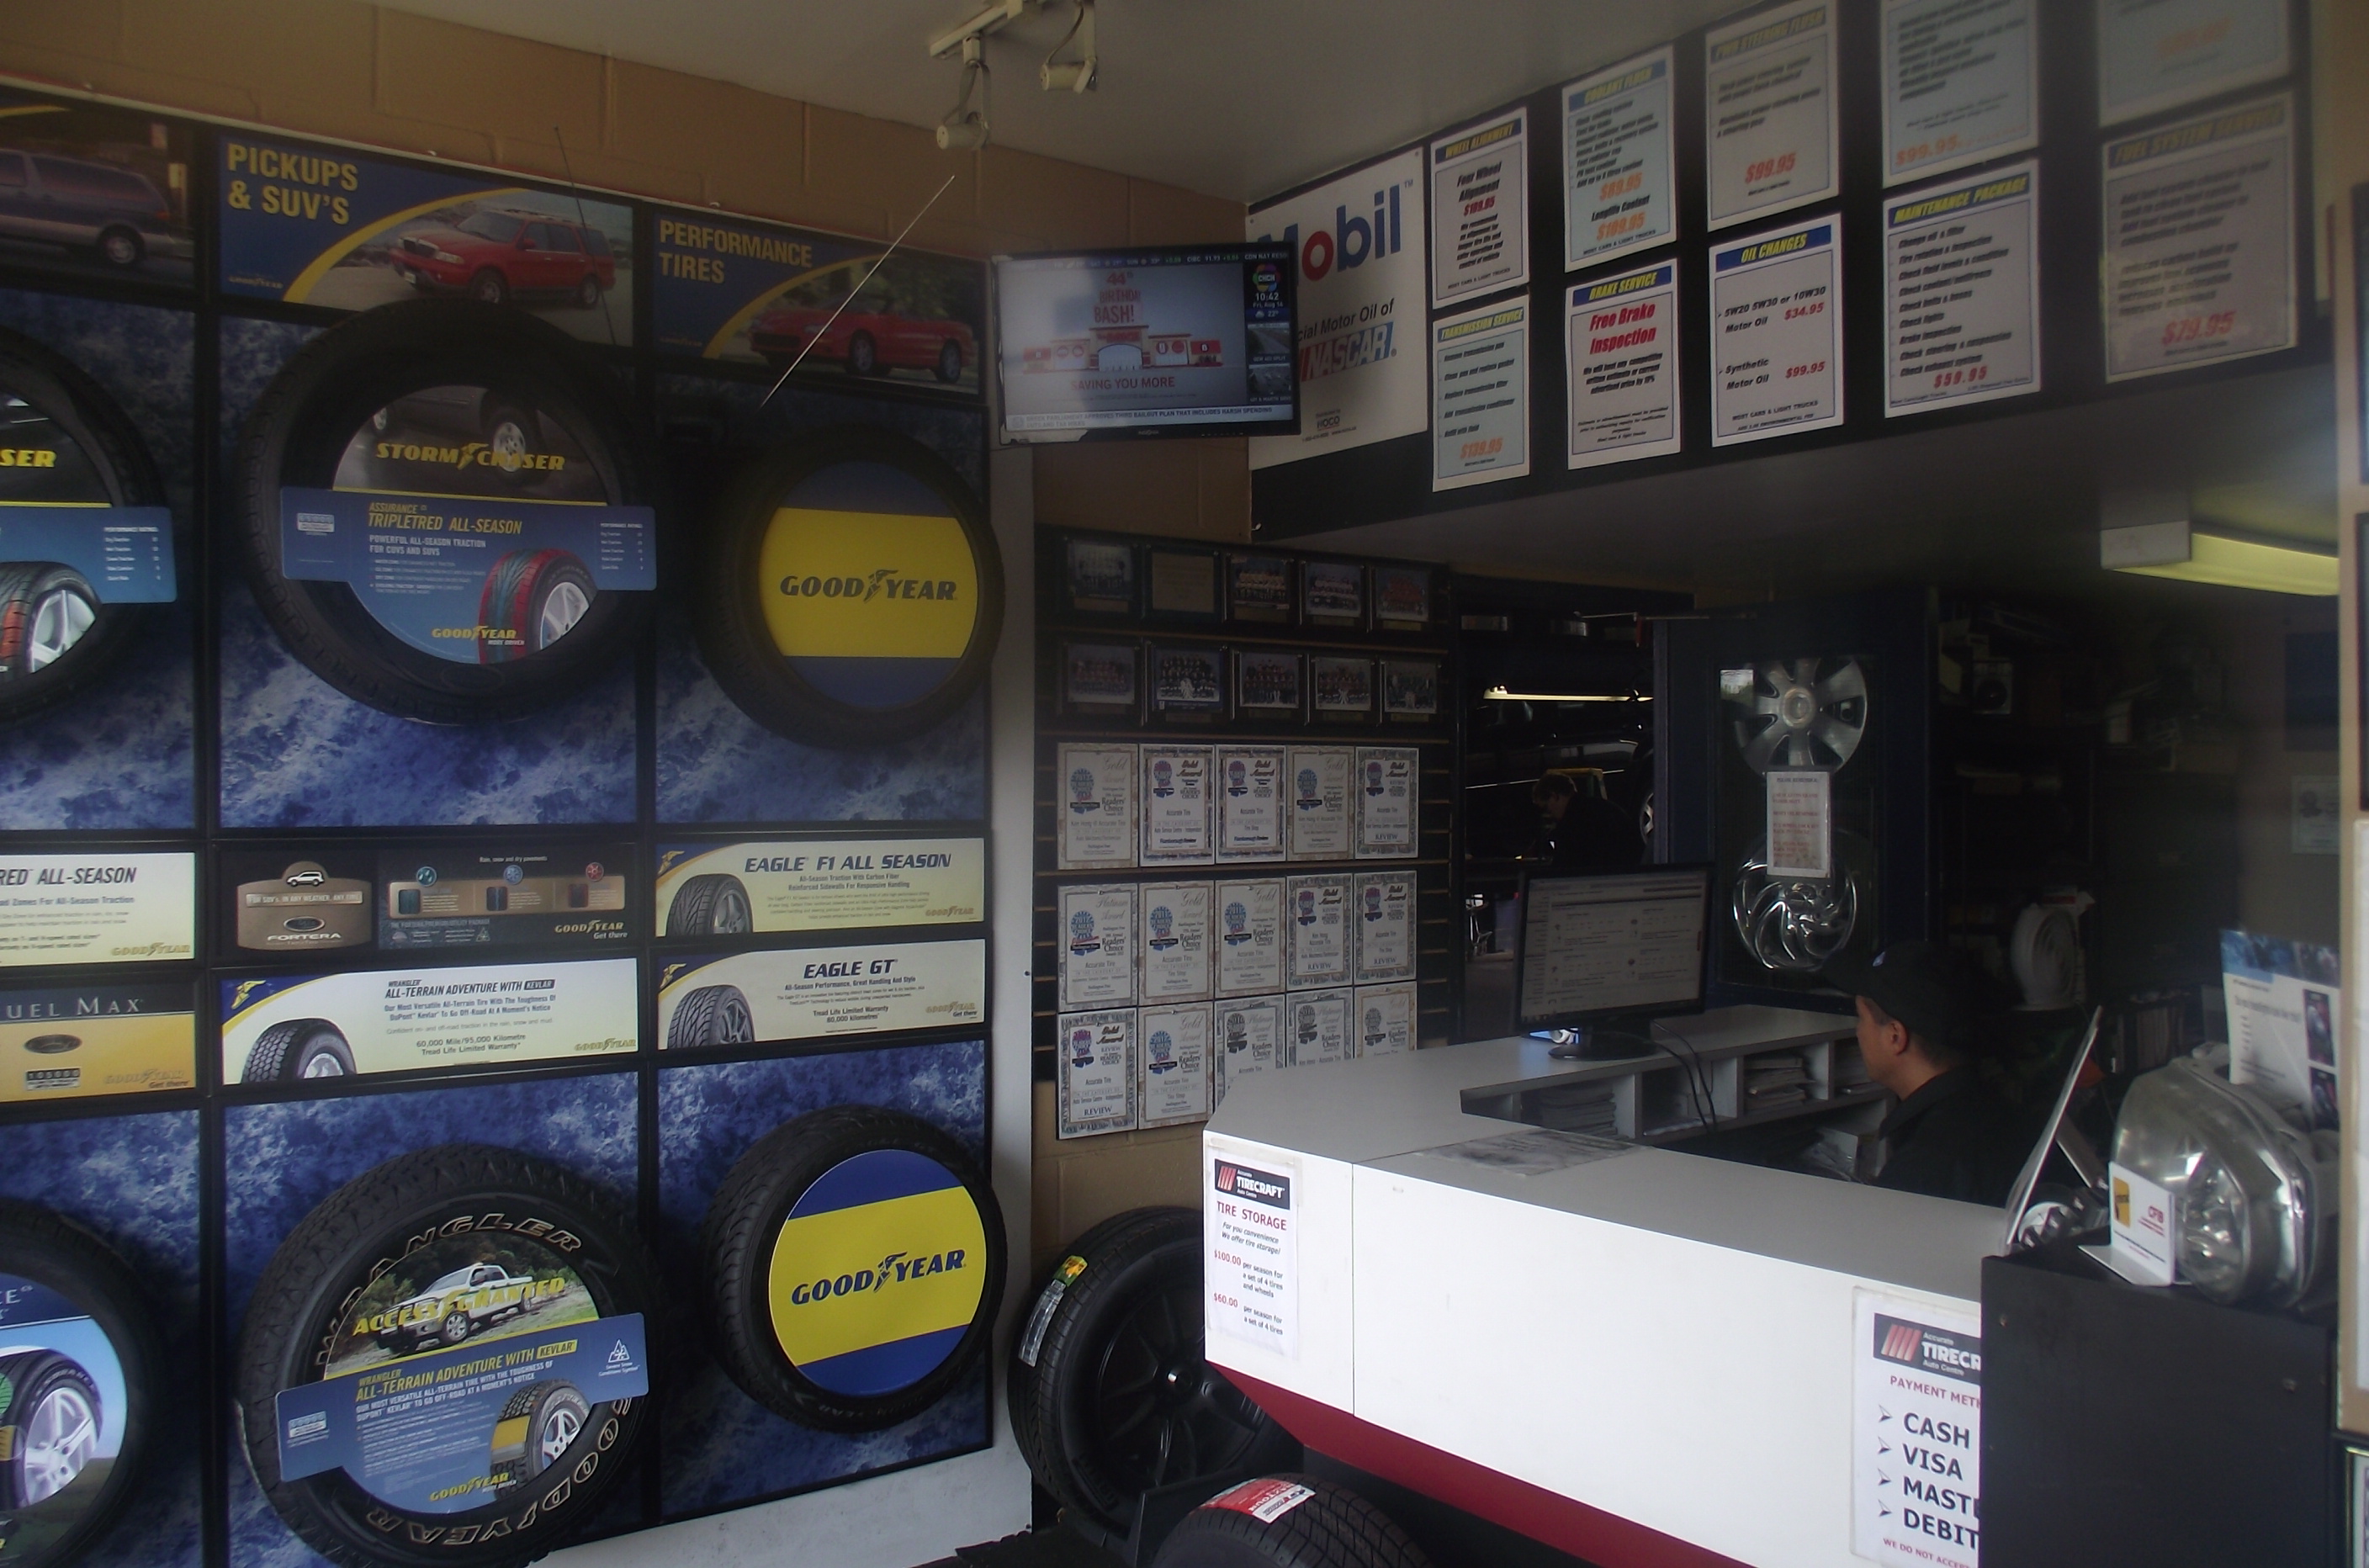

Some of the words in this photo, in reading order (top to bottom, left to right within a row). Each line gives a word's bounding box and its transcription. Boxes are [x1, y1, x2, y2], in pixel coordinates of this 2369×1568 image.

[228, 144, 358, 192] PICKUPS
[227, 180, 252, 210] &
[262, 185, 350, 225] SUV'S
[1895, 193, 1969, 223] MAINTENANCE
[1974, 177, 2027, 203] PACKAGE
[660, 219, 813, 268] PERFORMANCE
[1741, 245, 1757, 264] OIL
[1758, 233, 1809, 259] CHANGES
[659, 252, 725, 284] TIRES
[1589, 283, 1618, 301] BRAKE
[1619, 272, 1657, 294] SERVICE
[1255, 292, 1280, 302] 10:42
[1094, 304, 1136, 324] BASH!
[1321, 312, 1357, 334] Motor
[1359, 305, 1378, 325] Oil
[1381, 297, 1396, 316] of
[1589, 312, 1617, 332] Free
[1618, 302, 1656, 326] Brake
[1441, 316, 1492, 340] TRANSMISSION
[1493, 309, 1524, 326] SERVICE
[1725, 320, 1752, 334] Motor
[1754, 315, 1768, 328] Oil
[1589, 326, 1657, 356] Inspection
[1725, 358, 1770, 377] Synthetic
[1070, 379, 1112, 391] SAVING
[1115, 379, 1138, 390] YOU
[1141, 377, 1175, 389] MORE
[1725, 378, 1754, 391] Motor
[1756, 373, 1770, 385] Oil
[376, 442, 457, 464] STORM
[477, 449, 566, 471] CHASER
[368, 502, 417, 514] ASSURANCE
[368, 512, 443, 532] TRIPLETRED
[448, 516, 522, 535] ALL-SEASON
[369, 534, 408, 545] POWERFUL
[410, 537, 451, 547] ALL-SEASON
[453, 538, 486, 548] TRACTION
[369, 544, 384, 554] FOR
[406, 546, 420, 556] AND
[745, 856, 806, 873] EAGLE
[817, 856, 835, 871] F1
[840, 855, 874, 871] ALL
[881, 853, 951, 869] SEASON
[37, 866, 137, 885] ALL-SEASON
[820, 882, 845, 891] Sidewalls
[856, 882, 886, 890] Responsive
[888, 881, 909, 889] Handling
[268, 933, 342, 941] FORTERA
[594, 931, 607, 940] Get
[803, 961, 862, 978] EAGLE
[870, 959, 895, 974] GT
[384, 983, 444, 999] ALL-TERRAIN
[446, 982, 498, 995] ADVENTURE
[500, 981, 522, 992] WITH
[526, 980, 553, 989] KEVLAR
[388, 979, 422, 988] WRANGLER
[785, 983, 814, 992] All-Season
[869, 978, 891, 987] Handling
[416, 1039, 443, 1048] 60,000
[446, 1036, 491, 1046] Mile/95,000
[494, 1034, 526, 1043] Kilometre
[422, 1047, 440, 1056] Tread
[458, 1045, 485, 1053] Limited
[1237, 1176, 1283, 1199] TIRECRAFT
[1217, 1200, 1237, 1217] TIRE
[1242, 1208, 1287, 1231] STORAGE
[1222, 1221, 1232, 1230] For
[1232, 1225, 1243, 1233] you
[1243, 1227, 1279, 1244] convenience
[1222, 1231, 1231, 1239] We
[1232, 1233, 1244, 1243] offer
[1245, 1237, 1256, 1247] tire
[1257, 1241, 1281, 1256] storage!
[1214, 1249, 1241, 1266] $100.00
[1243, 1262, 1252, 1271] per
[1253, 1264, 1273, 1276] season
[1274, 1270, 1283, 1279] for
[1243, 1282, 1253, 1290] and
[1254, 1285, 1275, 1298] wheels
[1257, 1275, 1264, 1284] of
[1269, 1279, 1283, 1290] tires
[352, 1301, 446, 1336] ACCESS
[459, 1276, 565, 1311] GRANTED
[1213, 1292, 1238, 1307] $60.00
[1243, 1306, 1253, 1315] per
[1254, 1308, 1273, 1321] season
[1274, 1314, 1283, 1324] for
[1248, 1318, 1257, 1327] set
[1258, 1320, 1264, 1328] of
[1269, 1323, 1283, 1335] tires
[1922, 1332, 1954, 1346] Accurate
[356, 1371, 433, 1401] ALL-TERRAIN
[436, 1356, 503, 1381] ADVENTURE
[506, 1348, 534, 1365] WITH
[540, 1342, 574, 1357] KEVLAR
[1922, 1359, 1939, 1369] Auto
[1940, 1364, 1964, 1376] Centre
[359, 1369, 401, 1386] WRANGLER
[1889, 1375, 1947, 1399] PAYMENT
[1903, 1412, 1970, 1449] CASH
[1902, 1443, 1964, 1481] VISA
[1903, 1507, 1979, 1549] DEBIT
[1884, 1538, 1897, 1548] WE
[1900, 1543, 1913, 1554] DO
[1916, 1548, 1934, 1560] NOT
